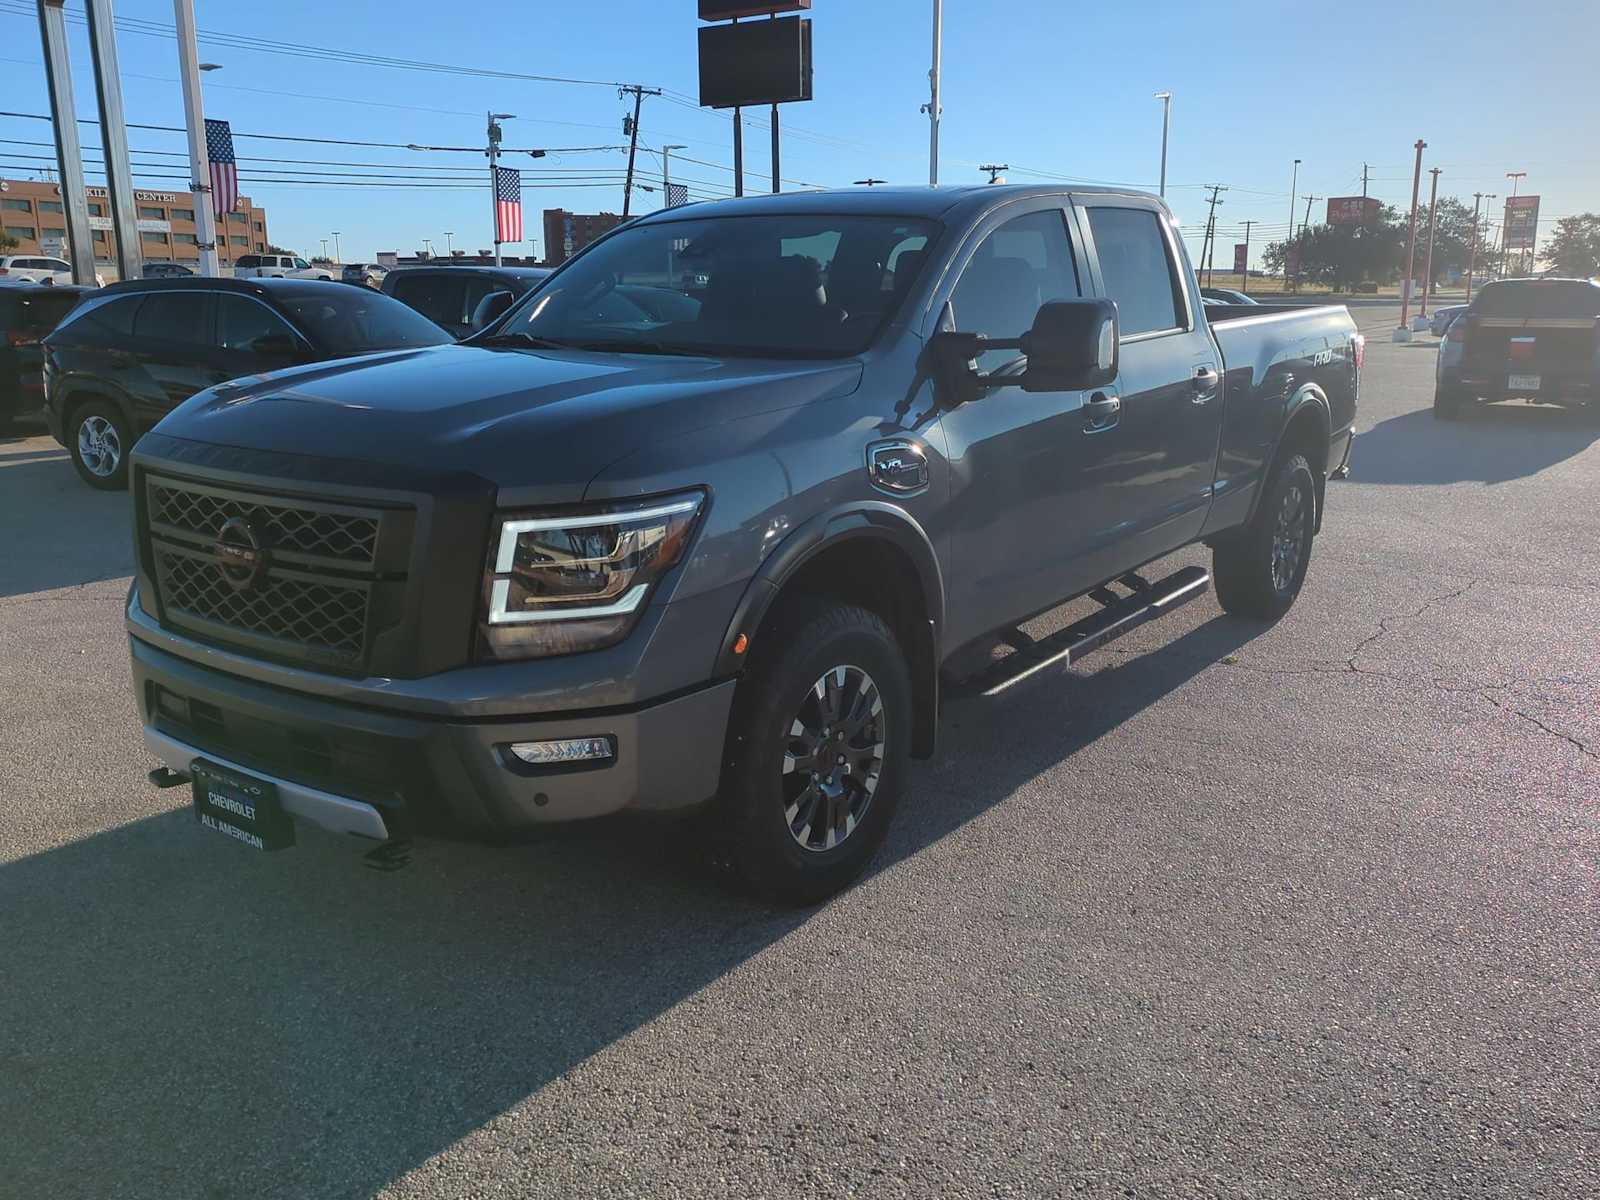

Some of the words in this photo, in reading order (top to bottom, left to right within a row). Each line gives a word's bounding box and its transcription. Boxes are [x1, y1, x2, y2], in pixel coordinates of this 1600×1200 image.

[136, 191, 177, 203] CENTER
[1313, 349, 1332, 367] PRO
[208, 791, 256, 821] CHEVROLET
[201, 813, 218, 831] ALL
[218, 821, 264, 850] AMERICAN
